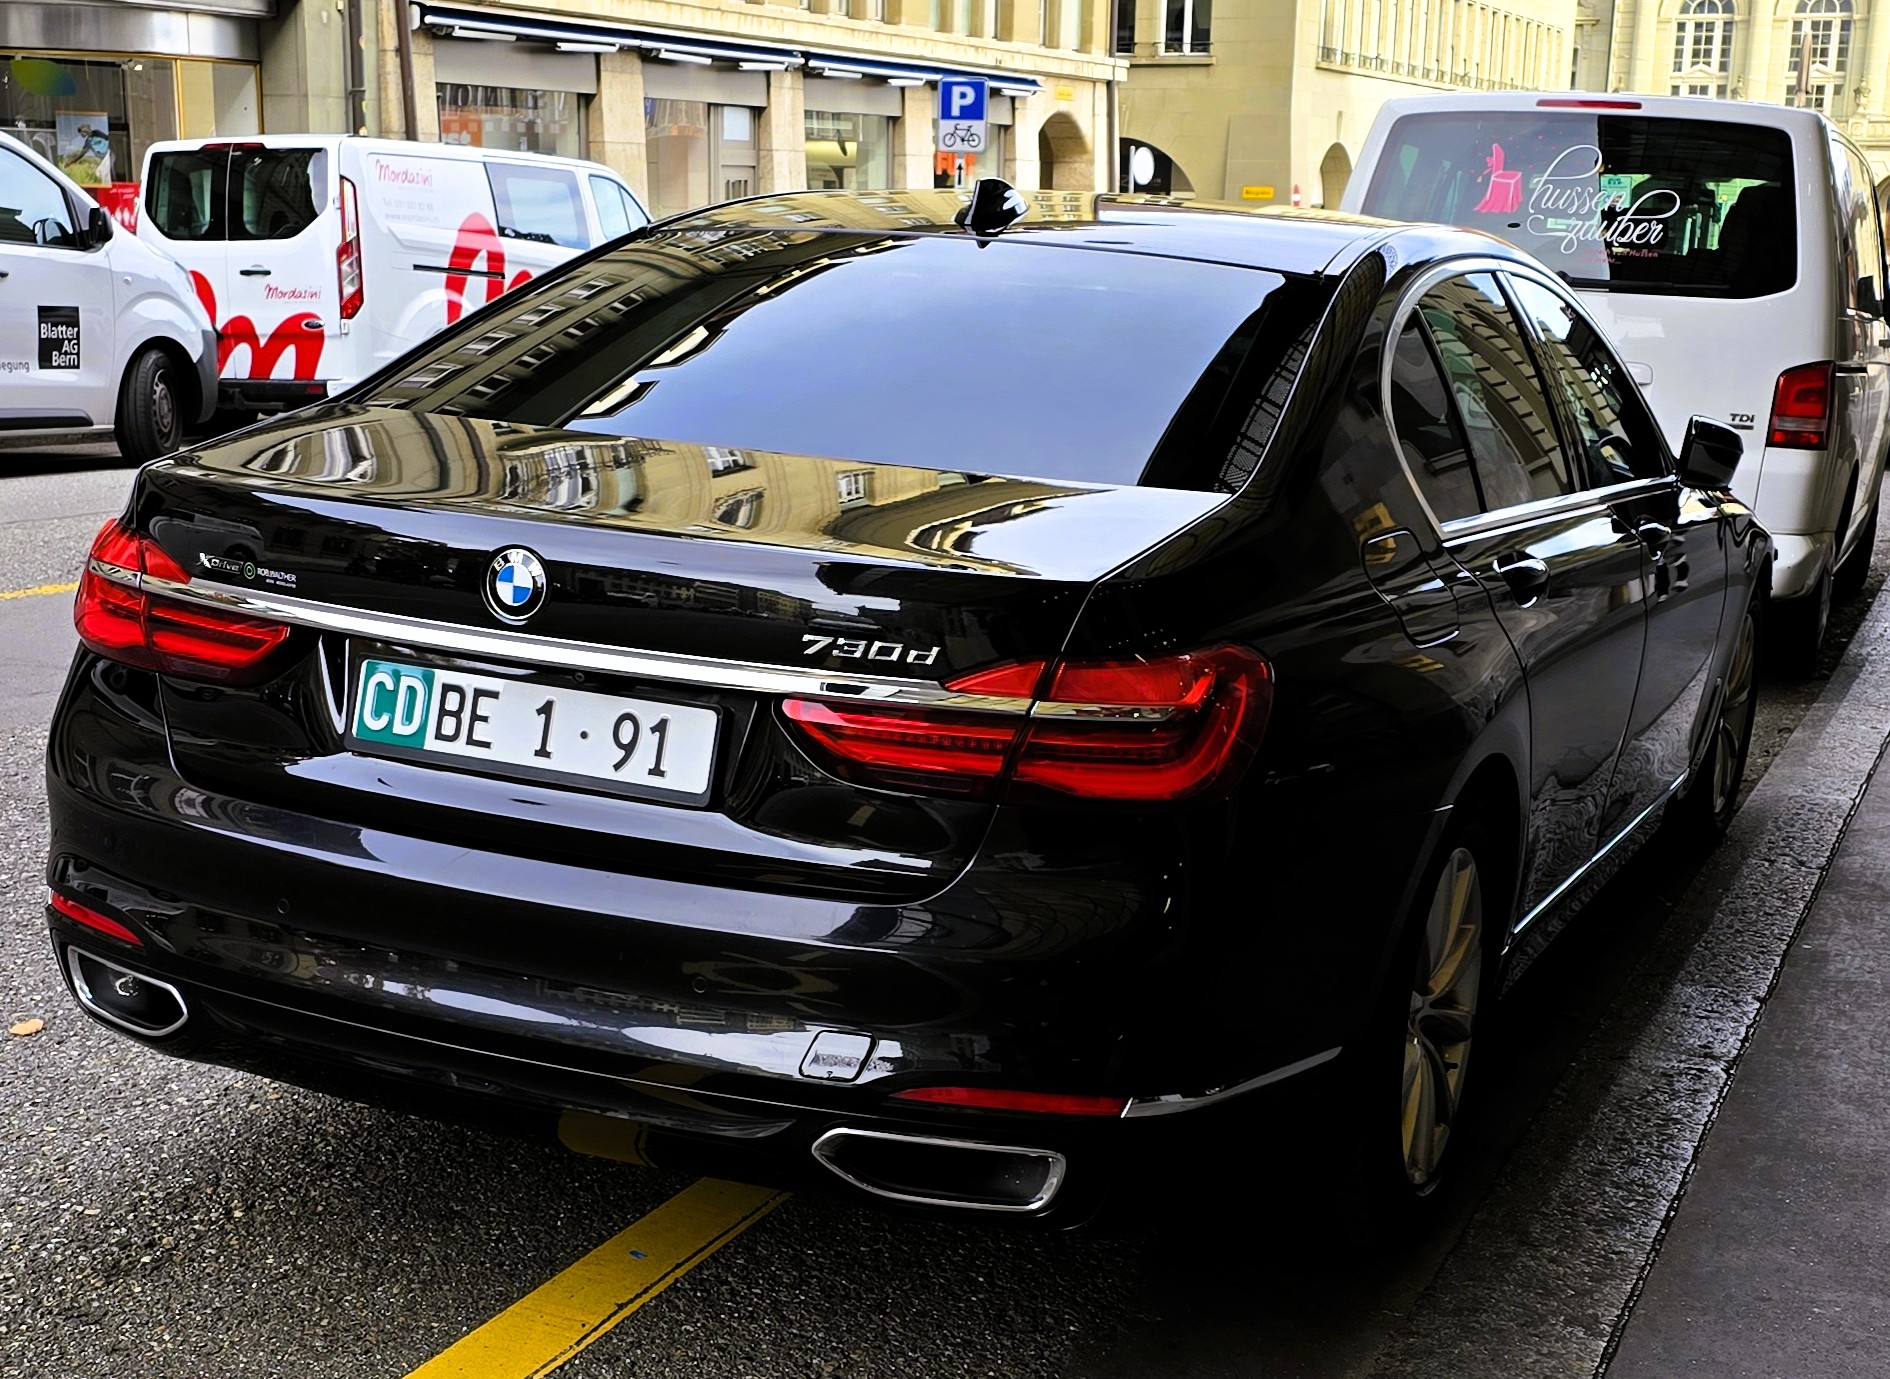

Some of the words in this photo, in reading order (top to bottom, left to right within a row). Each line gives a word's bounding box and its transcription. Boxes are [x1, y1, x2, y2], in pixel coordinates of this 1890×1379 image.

[951, 85, 976, 117] P
[375, 158, 433, 187] Mordasini
[1528, 145, 1627, 214] hussen
[1527, 189, 1681, 254] zauber
[264, 283, 322, 300] Mordasini
[40, 322, 79, 339] Blatter
[52, 350, 78, 367] Bern
[61, 340, 78, 354] AG
[0, 361, 30, 373] egung
[1729, 413, 1755, 423] TDI
[493, 551, 545, 588] BMW
[801, 633, 942, 665] 730d
[362, 671, 429, 737] CD
[434, 682, 501, 750] BE
